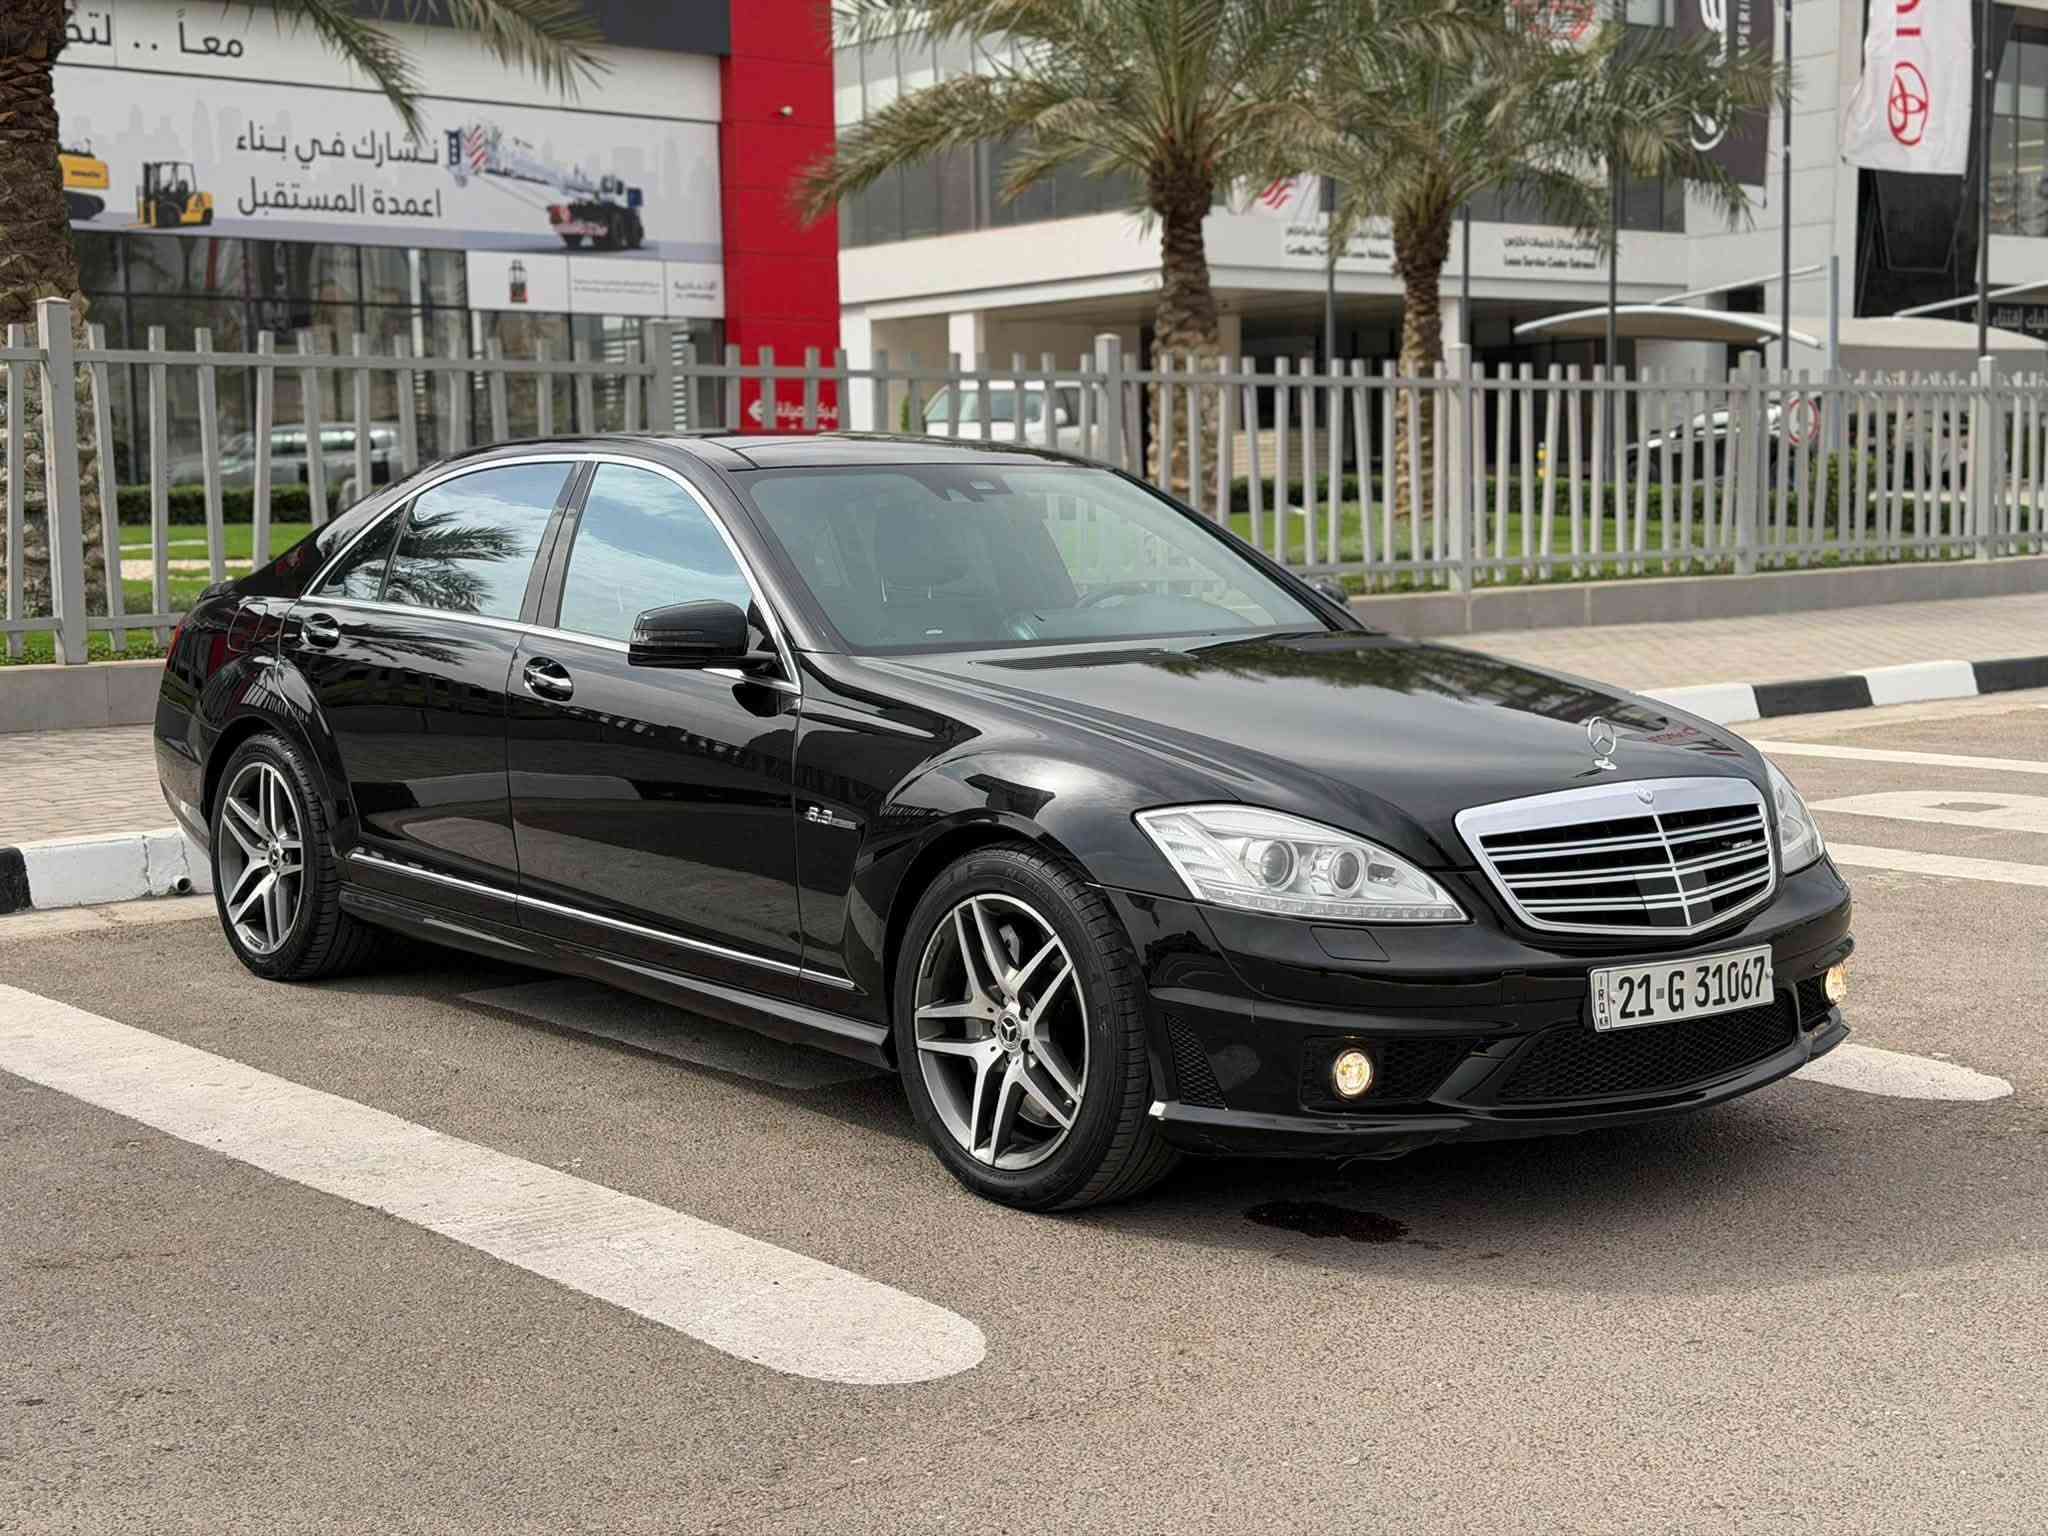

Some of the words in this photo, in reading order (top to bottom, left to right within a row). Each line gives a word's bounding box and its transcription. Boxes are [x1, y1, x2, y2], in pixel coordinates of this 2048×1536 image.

[236, 119, 287, 161] بناء
[295, 131, 345, 171] في
[353, 130, 439, 168] نشارك
[237, 175, 366, 217] المستقبل
[371, 188, 442, 218] اعمدة
[1618, 973, 1655, 1020] 21
[1667, 970, 1685, 1013] G
[1694, 955, 1766, 1008] 31067
